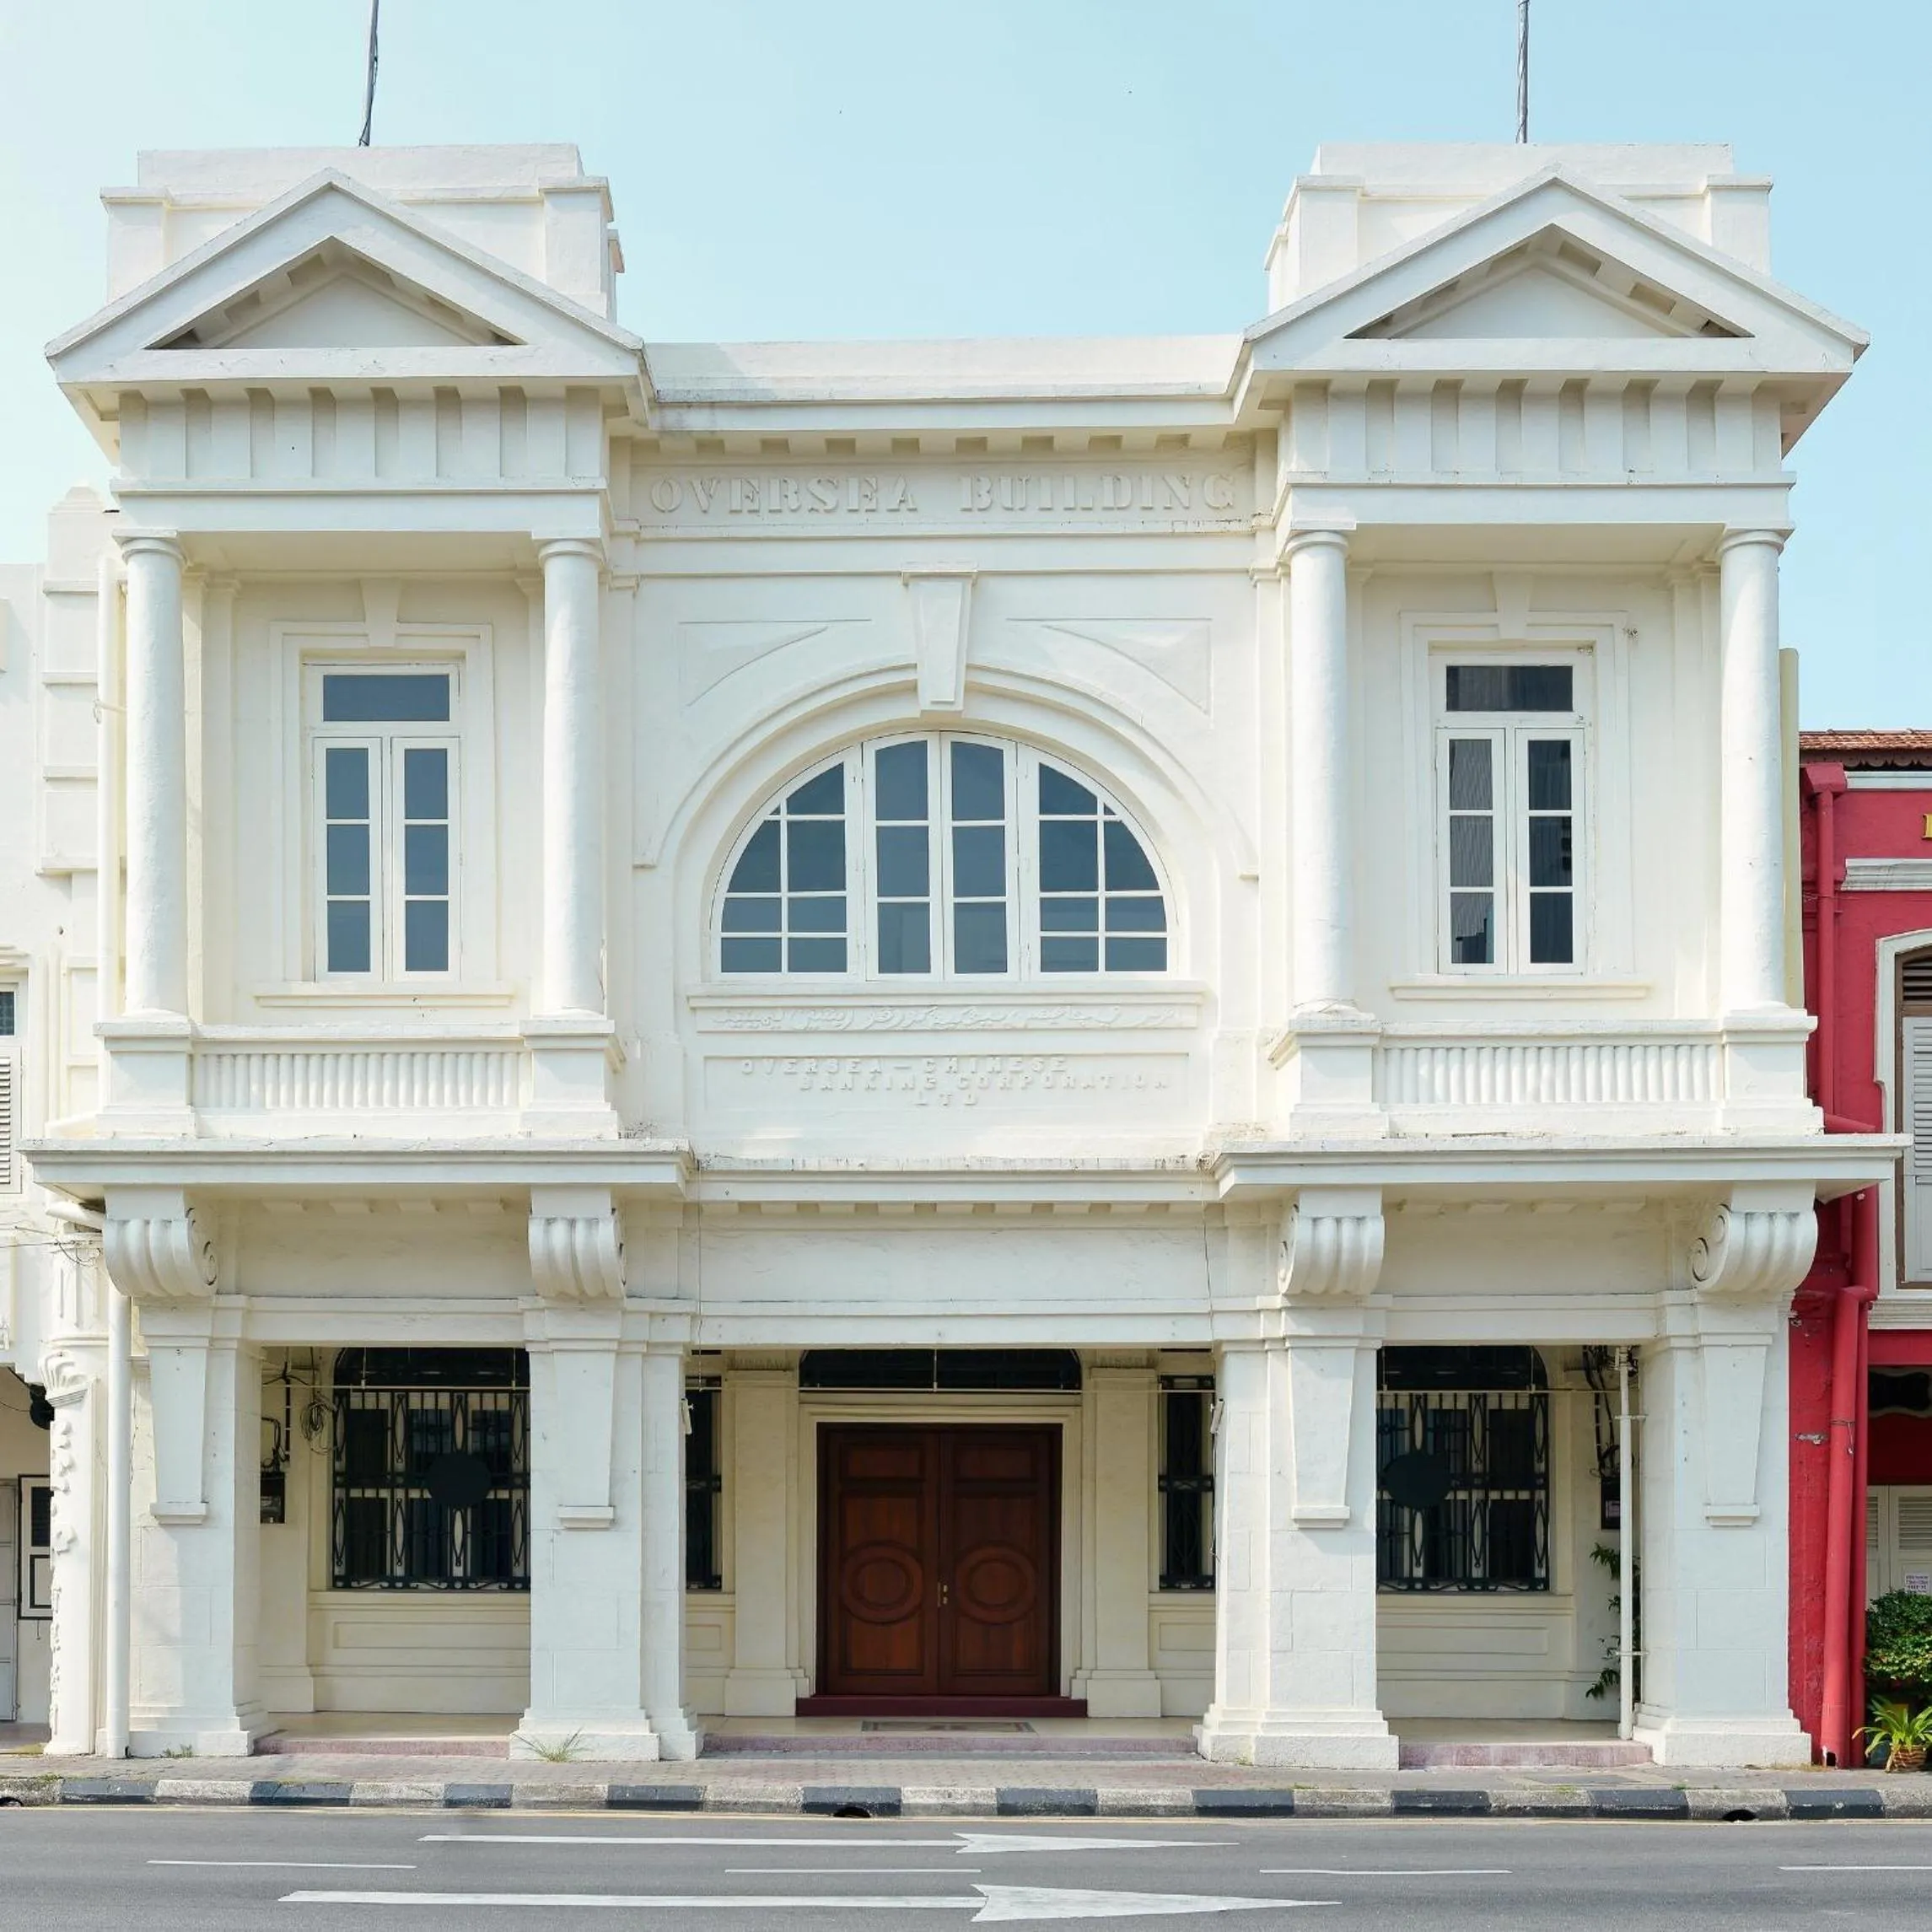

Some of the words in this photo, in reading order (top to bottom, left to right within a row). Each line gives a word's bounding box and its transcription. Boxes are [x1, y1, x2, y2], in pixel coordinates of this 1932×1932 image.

[650, 476, 918, 514] OVERSEA
[960, 472, 1236, 512] BUILDING
[799, 1074, 937, 1091] BANKING
[957, 1073, 1168, 1090] CORPORATION
